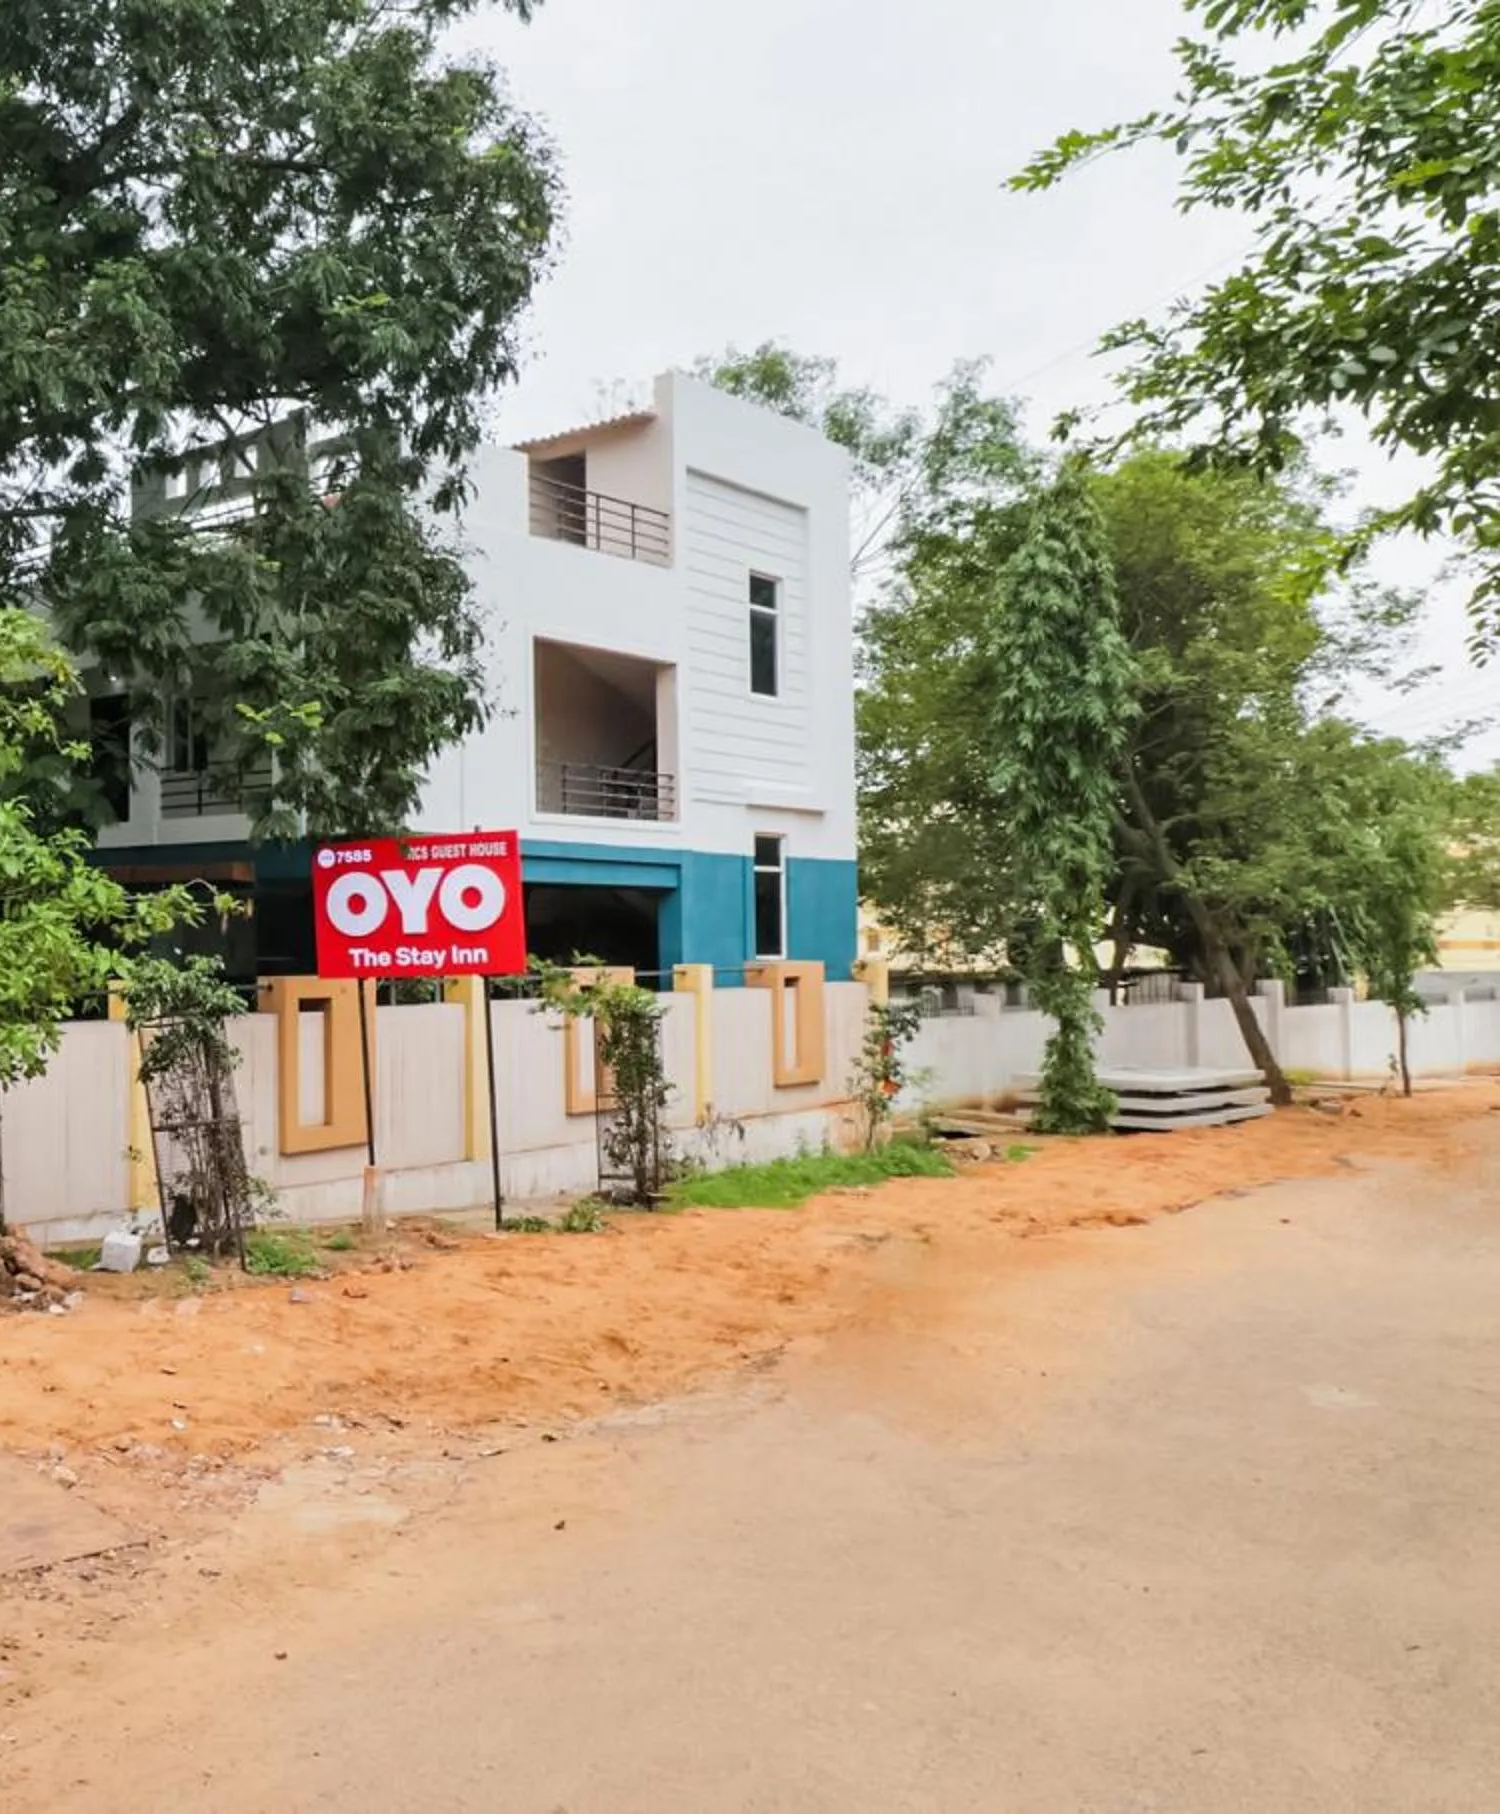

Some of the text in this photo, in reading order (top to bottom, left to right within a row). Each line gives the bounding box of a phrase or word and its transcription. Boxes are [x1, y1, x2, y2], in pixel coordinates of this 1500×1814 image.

[336, 849, 372, 864] 7585
[431, 843, 466, 859] GUEST
[469, 841, 508, 857] HOUSE
[326, 863, 506, 937] OYO
[348, 944, 489, 969] The Stay Inn
